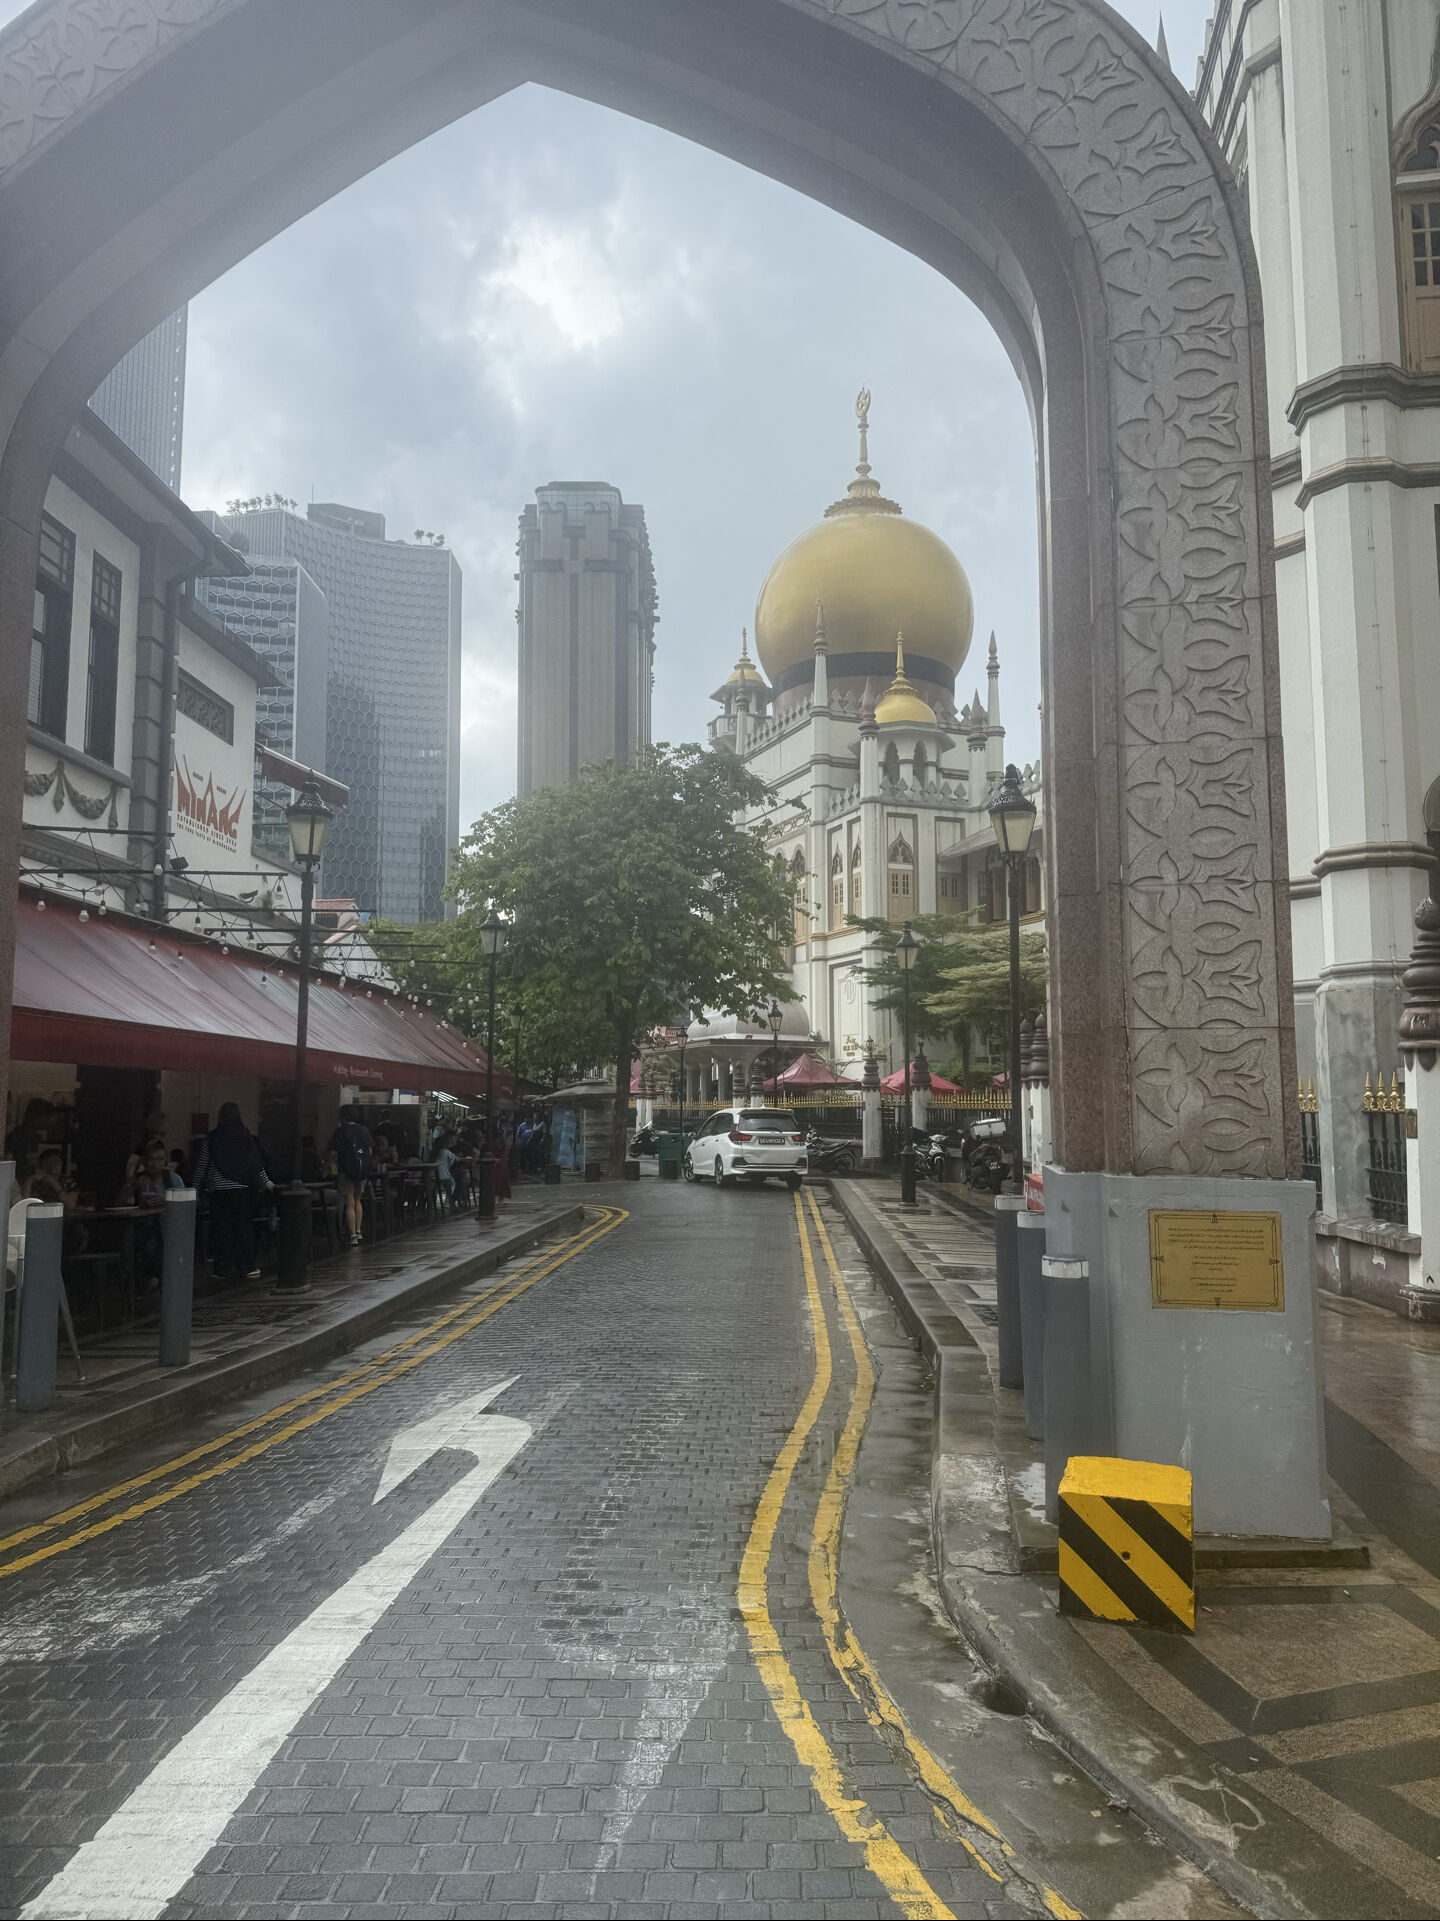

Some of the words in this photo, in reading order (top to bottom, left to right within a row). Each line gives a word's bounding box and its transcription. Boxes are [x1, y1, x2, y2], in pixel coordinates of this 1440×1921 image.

[174, 753, 247, 839] MINANG
[177, 813, 209, 834] ESTABLISHED
[211, 830, 224, 841] SINCE
